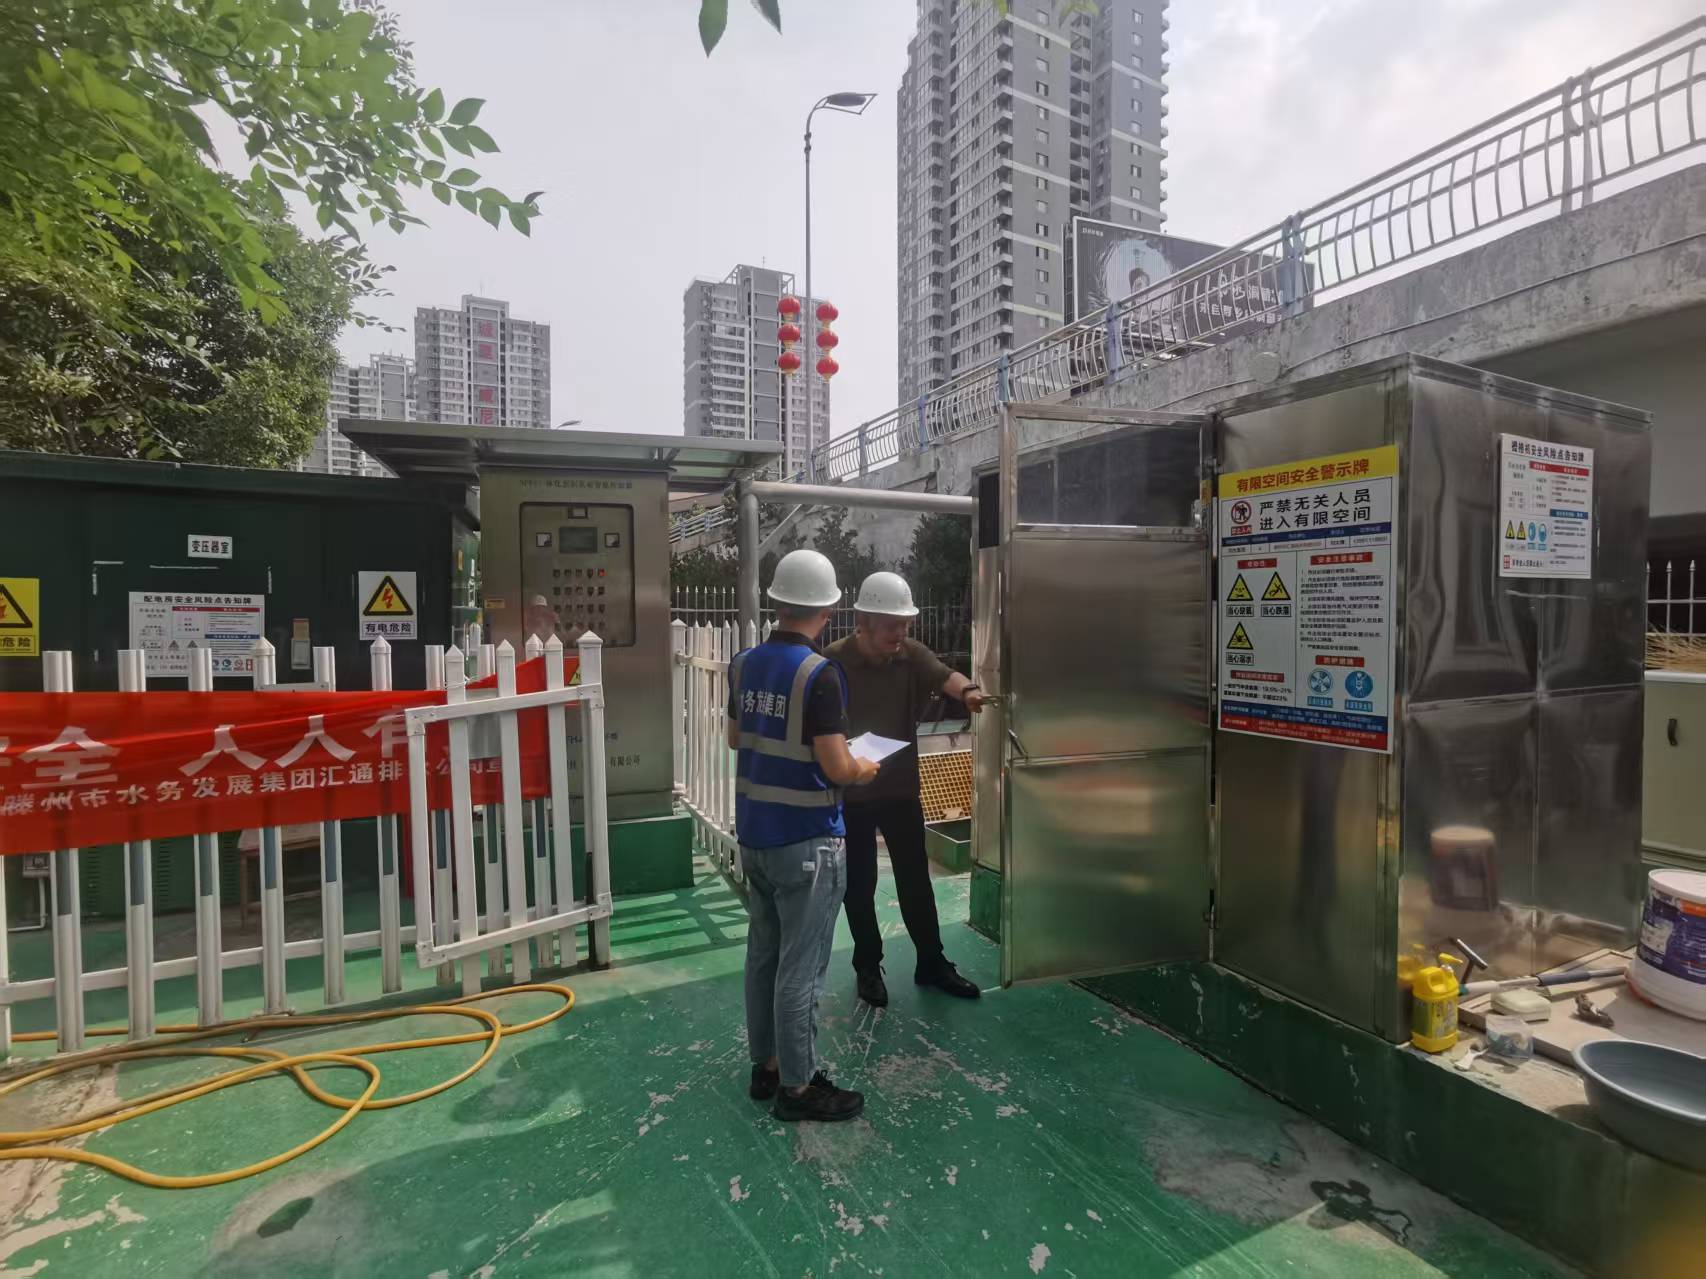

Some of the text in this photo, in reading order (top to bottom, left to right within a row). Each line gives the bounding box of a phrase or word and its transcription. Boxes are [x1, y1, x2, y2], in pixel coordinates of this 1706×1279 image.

[1236, 459, 1369, 492] 有限空间安全警示牌
[1260, 488, 1371, 515] 严禁无关人员
[1260, 506, 1371, 531] 进入有限空间
[192, 540, 229, 554] 变压器室
[143, 595, 252, 605] 配电房安全风险点告知牌
[365, 622, 411, 633] 有电危险
[0, 636, 31, 648] 危险
[179, 705, 409, 777] 人人有
[0, 726, 121, 790] 全
[610, 754, 641, 769] 有限公司
